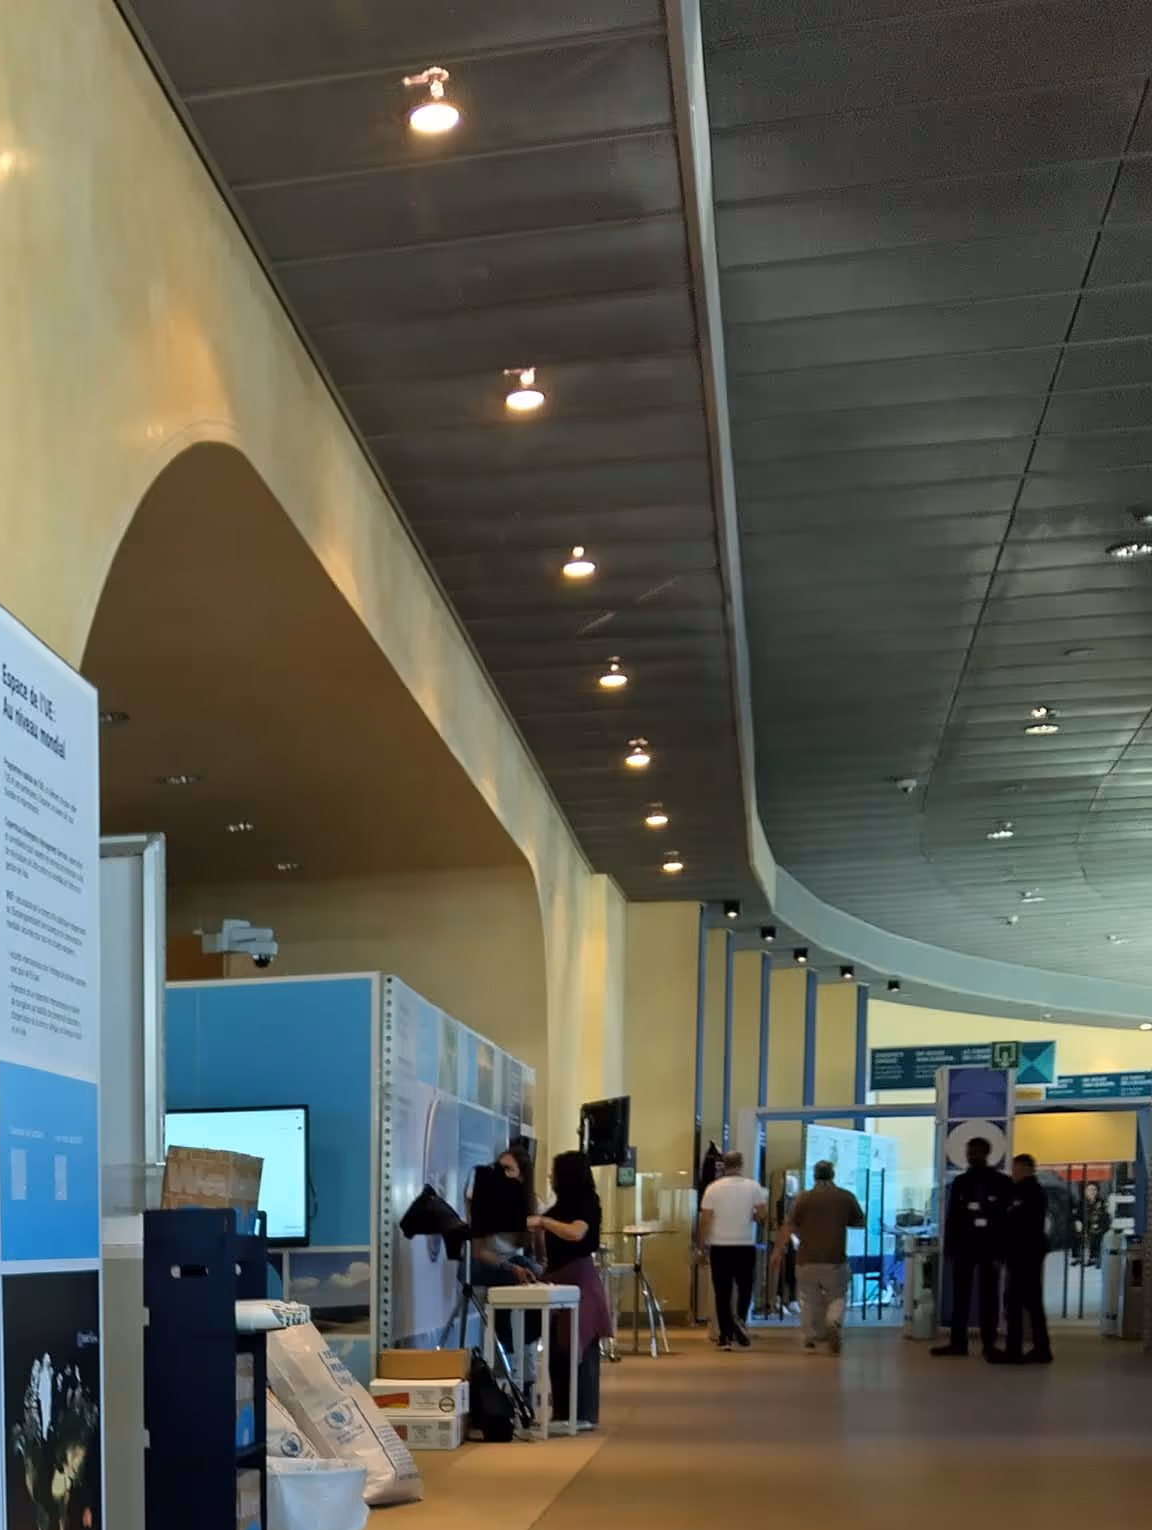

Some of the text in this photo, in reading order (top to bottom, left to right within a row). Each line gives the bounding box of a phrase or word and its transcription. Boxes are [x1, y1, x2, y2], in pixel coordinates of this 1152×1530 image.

[2, 662, 28, 701] Espace
[29, 684, 38, 710] de
[15, 707, 39, 740] niveau
[39, 727, 66, 761] mondial
